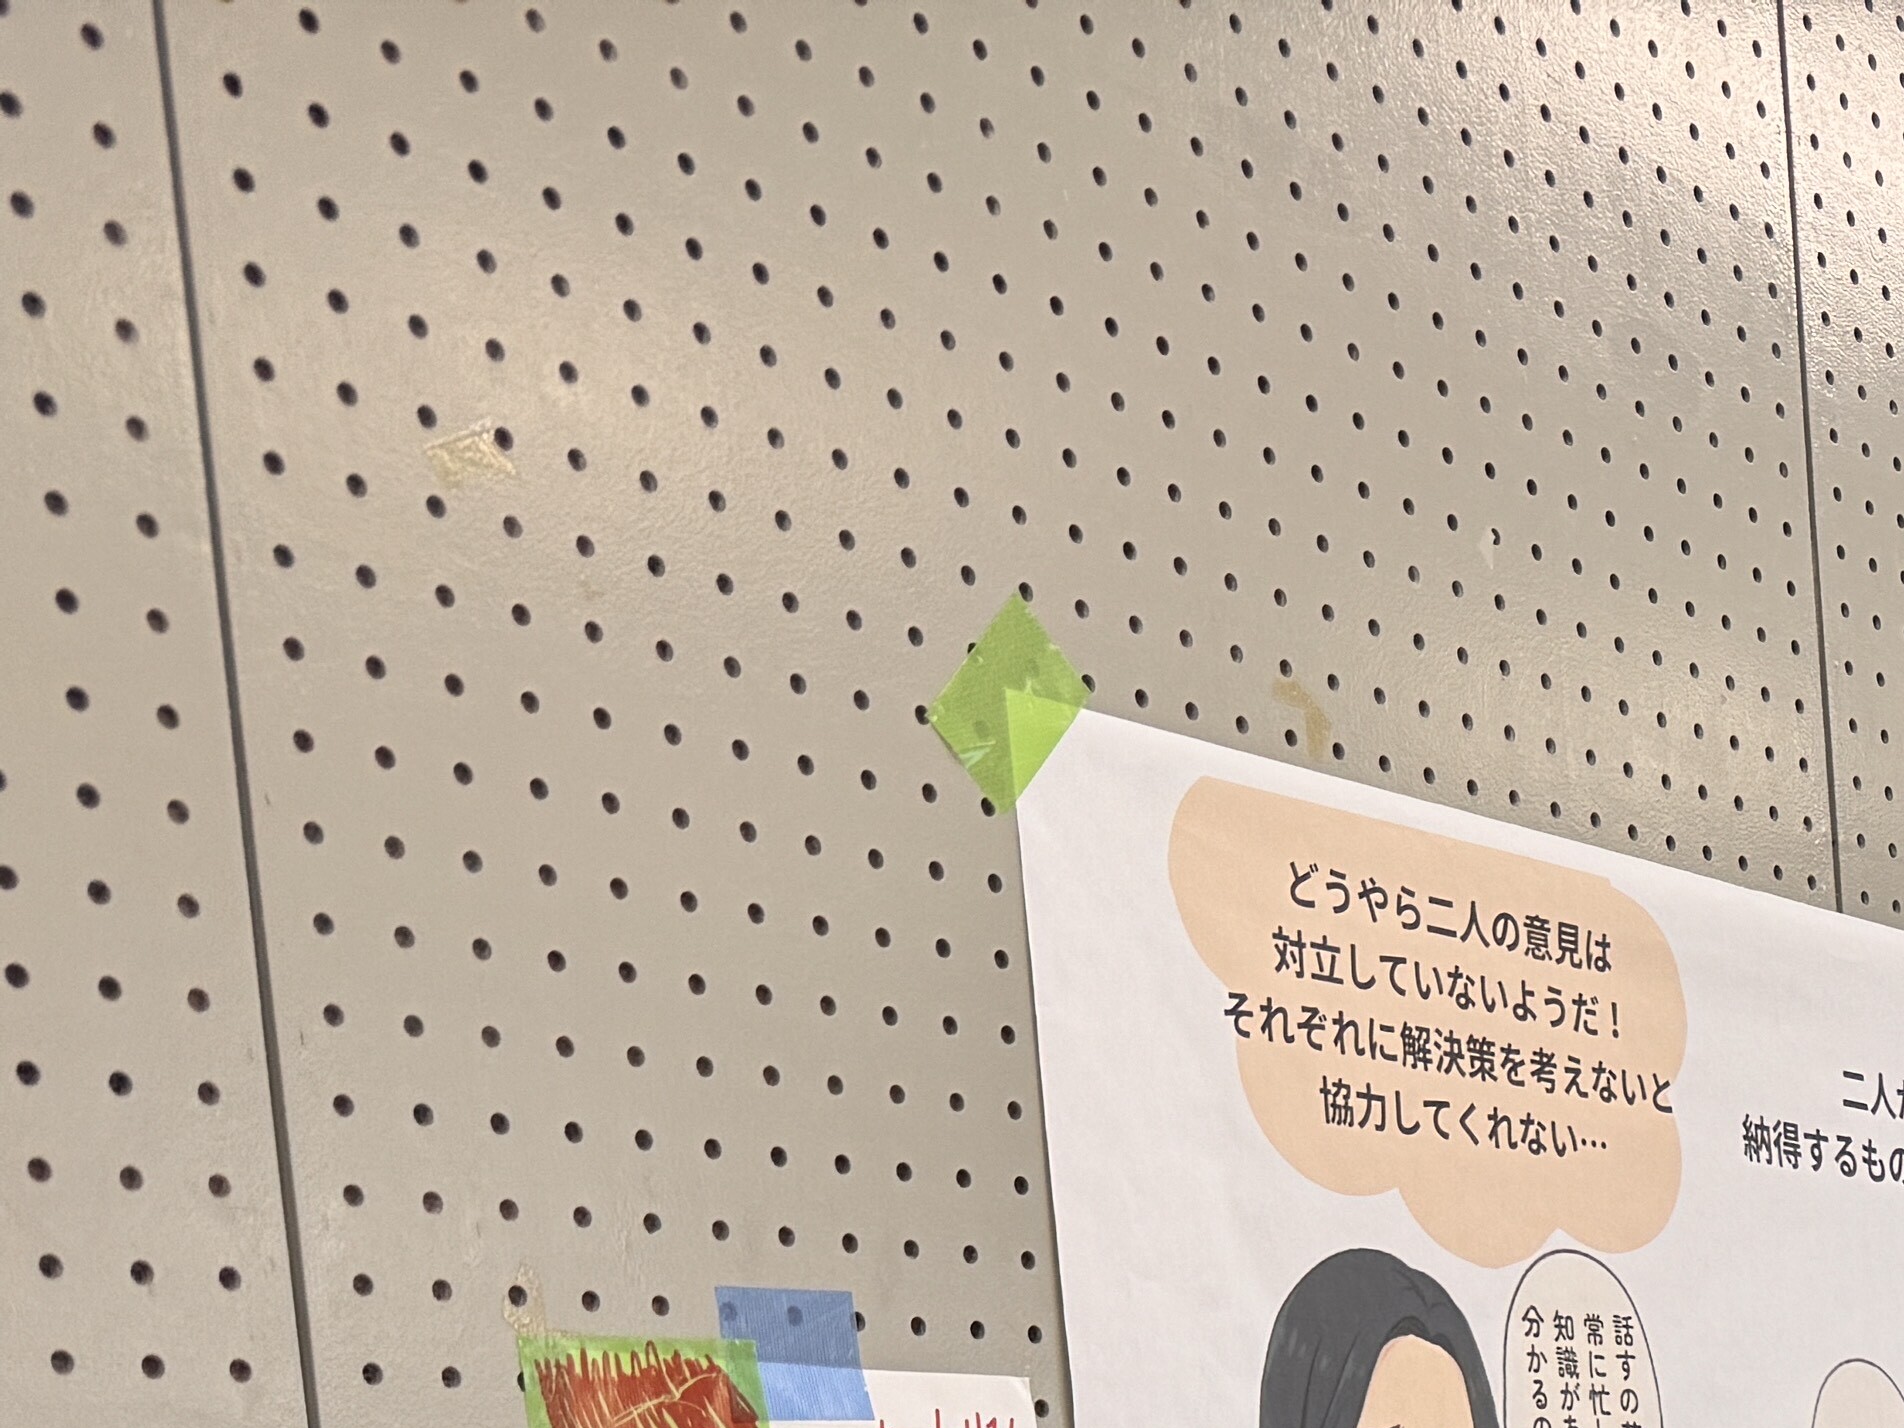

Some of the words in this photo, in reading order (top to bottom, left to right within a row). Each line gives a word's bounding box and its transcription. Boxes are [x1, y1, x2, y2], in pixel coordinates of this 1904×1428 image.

[1287, 861, 1613, 974] どうやら二人の意見は
[1272, 926, 1620, 1039] 対立していないようだ！
[1223, 992, 1675, 1115] それぞれに解決策を考えないと
[1319, 1076, 1608, 1159] 協力してくれない…
